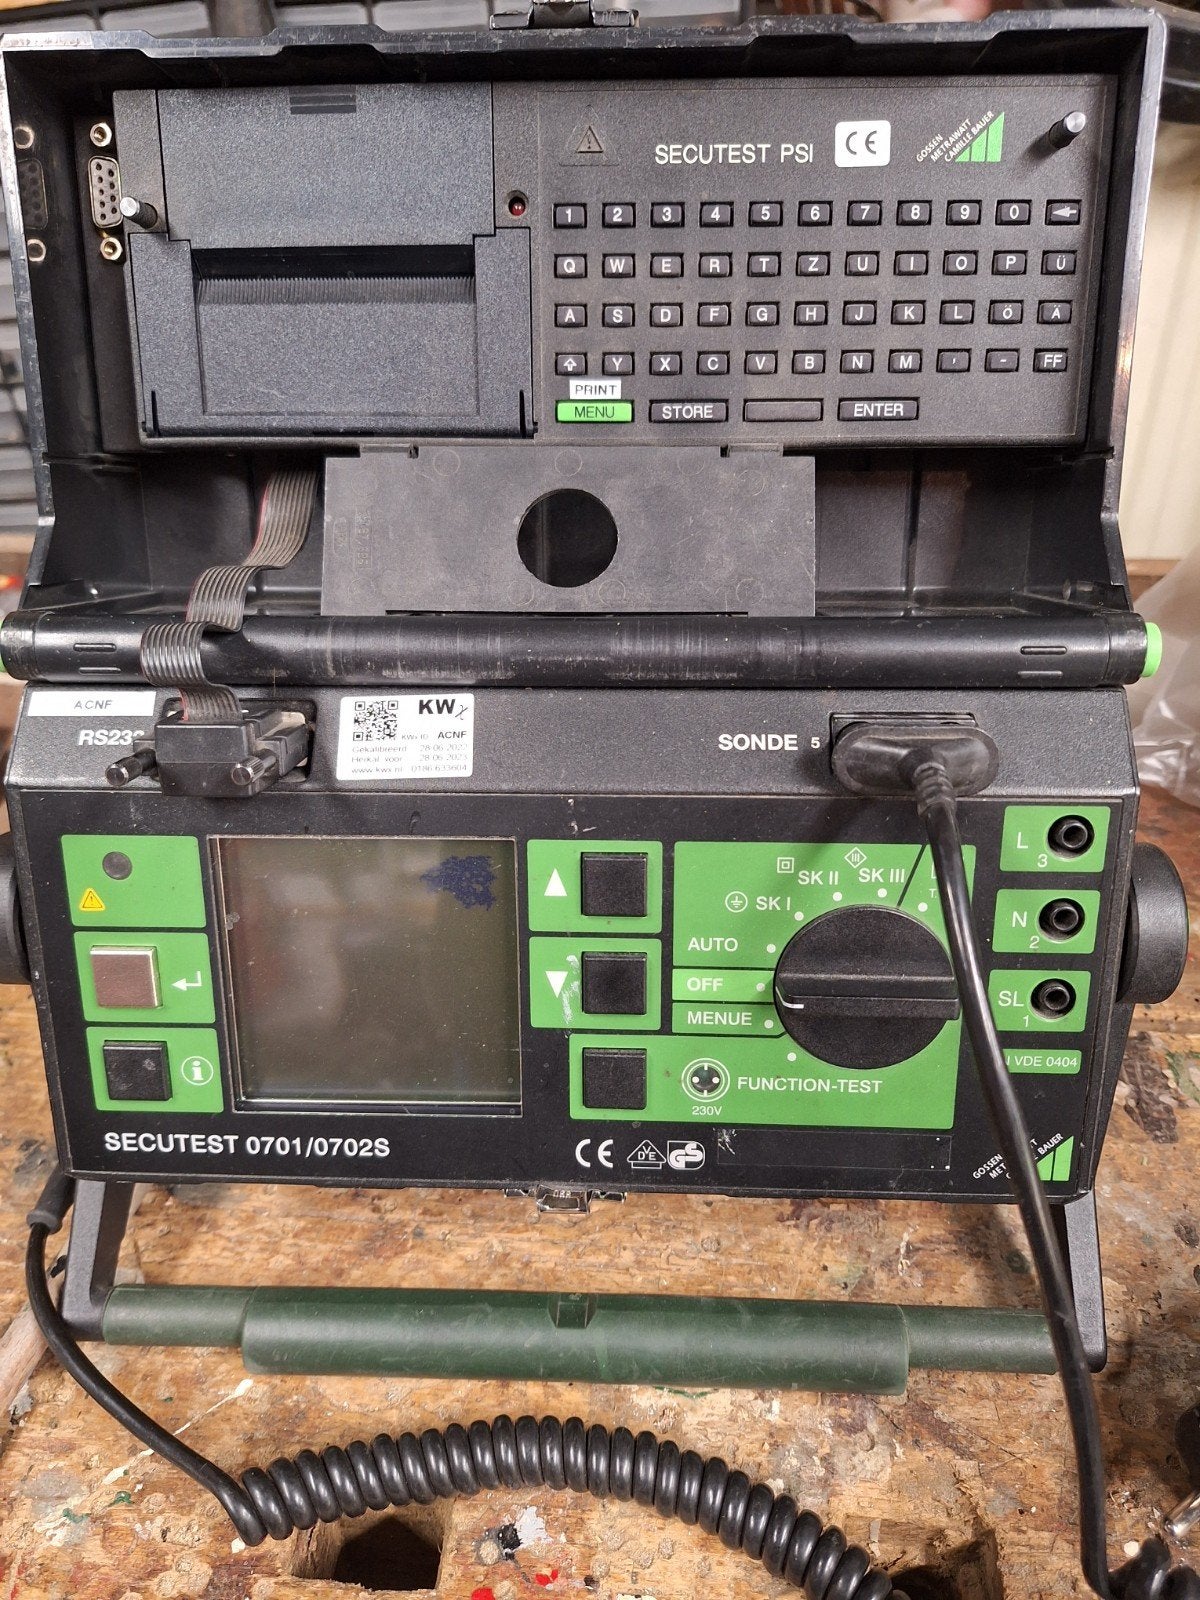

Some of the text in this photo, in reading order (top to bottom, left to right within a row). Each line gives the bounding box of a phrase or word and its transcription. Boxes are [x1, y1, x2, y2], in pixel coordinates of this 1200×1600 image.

[846, 130, 877, 155] CE
[930, 118, 972, 162] METRAWATT
[944, 110, 994, 162] CAMILLE BAUER
[655, 143, 814, 164] SECUTEST PSI
[916, 133, 944, 162] GOSSEN
[565, 205, 1019, 223] 1 2 3 4 5 6 7 8 9 0
[564, 259, 576, 274] Q
[610, 259, 625, 273] W
[661, 259, 671, 272] E
[710, 259, 720, 272] R
[759, 258, 769, 272] T
[808, 257, 819, 272] Z
[858, 257, 868, 271] U
[956, 256, 968, 271] O
[1006, 255, 1017, 270] P
[1056, 255, 1066, 270] Ü
[564, 304, 1061, 323] A S D F G H J K L Ö Ä
[612, 357, 623, 371] Y
[660, 357, 671, 371] X
[707, 357, 719, 370] C
[755, 356, 766, 370] V
[805, 356, 815, 369] B
[852, 356, 863, 369] N
[900, 356, 912, 369] M
[1043, 355, 1063, 368] FF
[575, 384, 617, 395] PRINT
[574, 406, 615, 418] MENU
[662, 405, 713, 419] STORE
[853, 403, 904, 417] ENTER
[74, 700, 113, 709] ACNF
[437, 730, 467, 739] ACNF
[718, 733, 820, 752] SONDE 5
[1016, 832, 1029, 849] L
[1037, 853, 1048, 868] 3
[798, 870, 839, 885] SK II
[858, 868, 905, 883] SK III
[755, 896, 781, 911] SK
[1012, 911, 1027, 928] N
[687, 937, 738, 952] AUTO
[1029, 936, 1040, 949] 2
[687, 978, 723, 991] OFF
[998, 990, 1024, 1008] SL
[687, 1011, 752, 1026] MENUE
[1023, 1015, 1030, 1028] 1
[1014, 1056, 1043, 1067] VDE
[1046, 1056, 1077, 1067] 0404
[737, 1076, 883, 1094] FUNCTION-TEST
[691, 1105, 723, 1116] 230V
[104, 1132, 391, 1158] SECUTEST 0701/0702S
[1037, 1132, 1064, 1155] BAUER
[575, 1138, 614, 1169] CE
[972, 1153, 1003, 1179] GOSSEN
